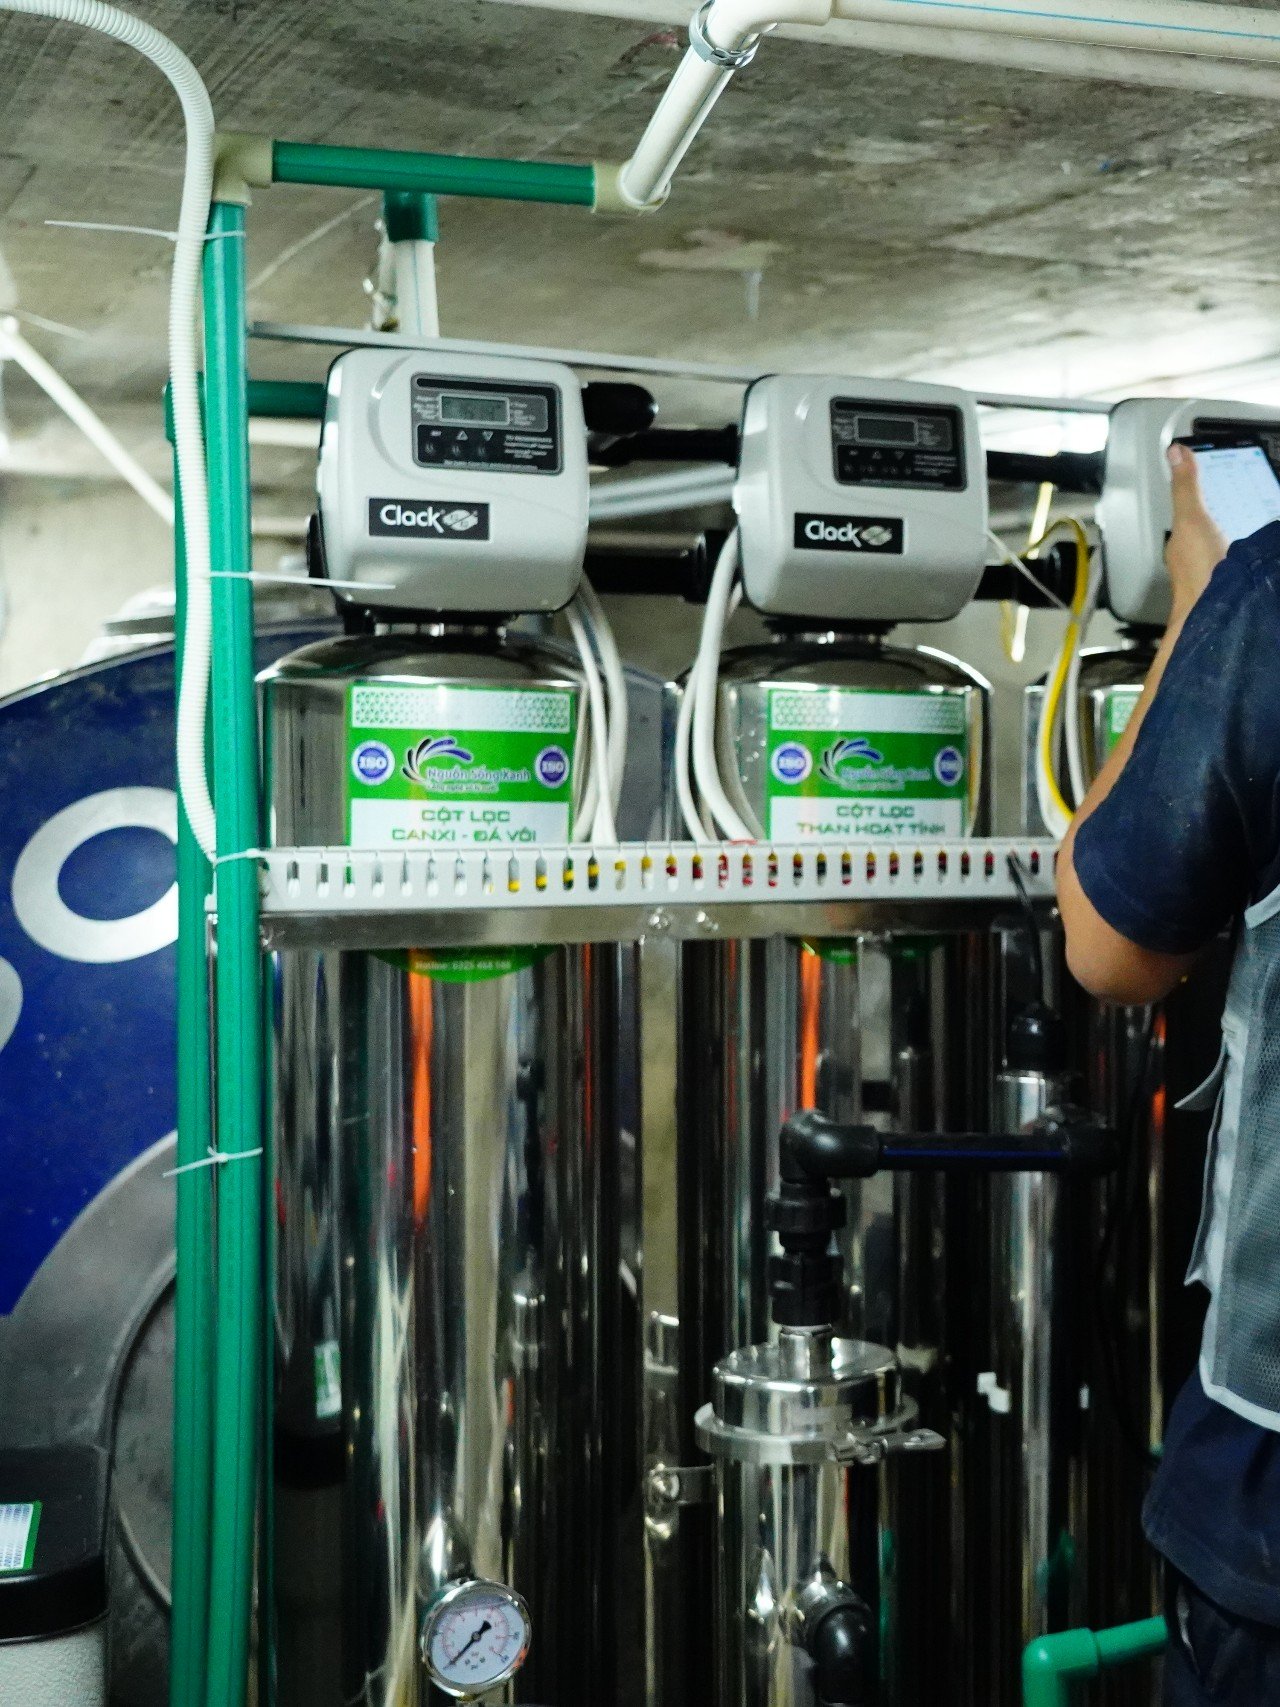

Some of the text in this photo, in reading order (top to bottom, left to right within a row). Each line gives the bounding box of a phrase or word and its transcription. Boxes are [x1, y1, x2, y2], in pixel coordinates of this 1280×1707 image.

[380, 504, 445, 534] Clack
[804, 520, 862, 548] Clack
[421, 807, 511, 828] CỘT LỌC
[836, 803, 875, 820] CỘT
[391, 829, 457, 842] CANXI
[797, 823, 851, 835] THAN
